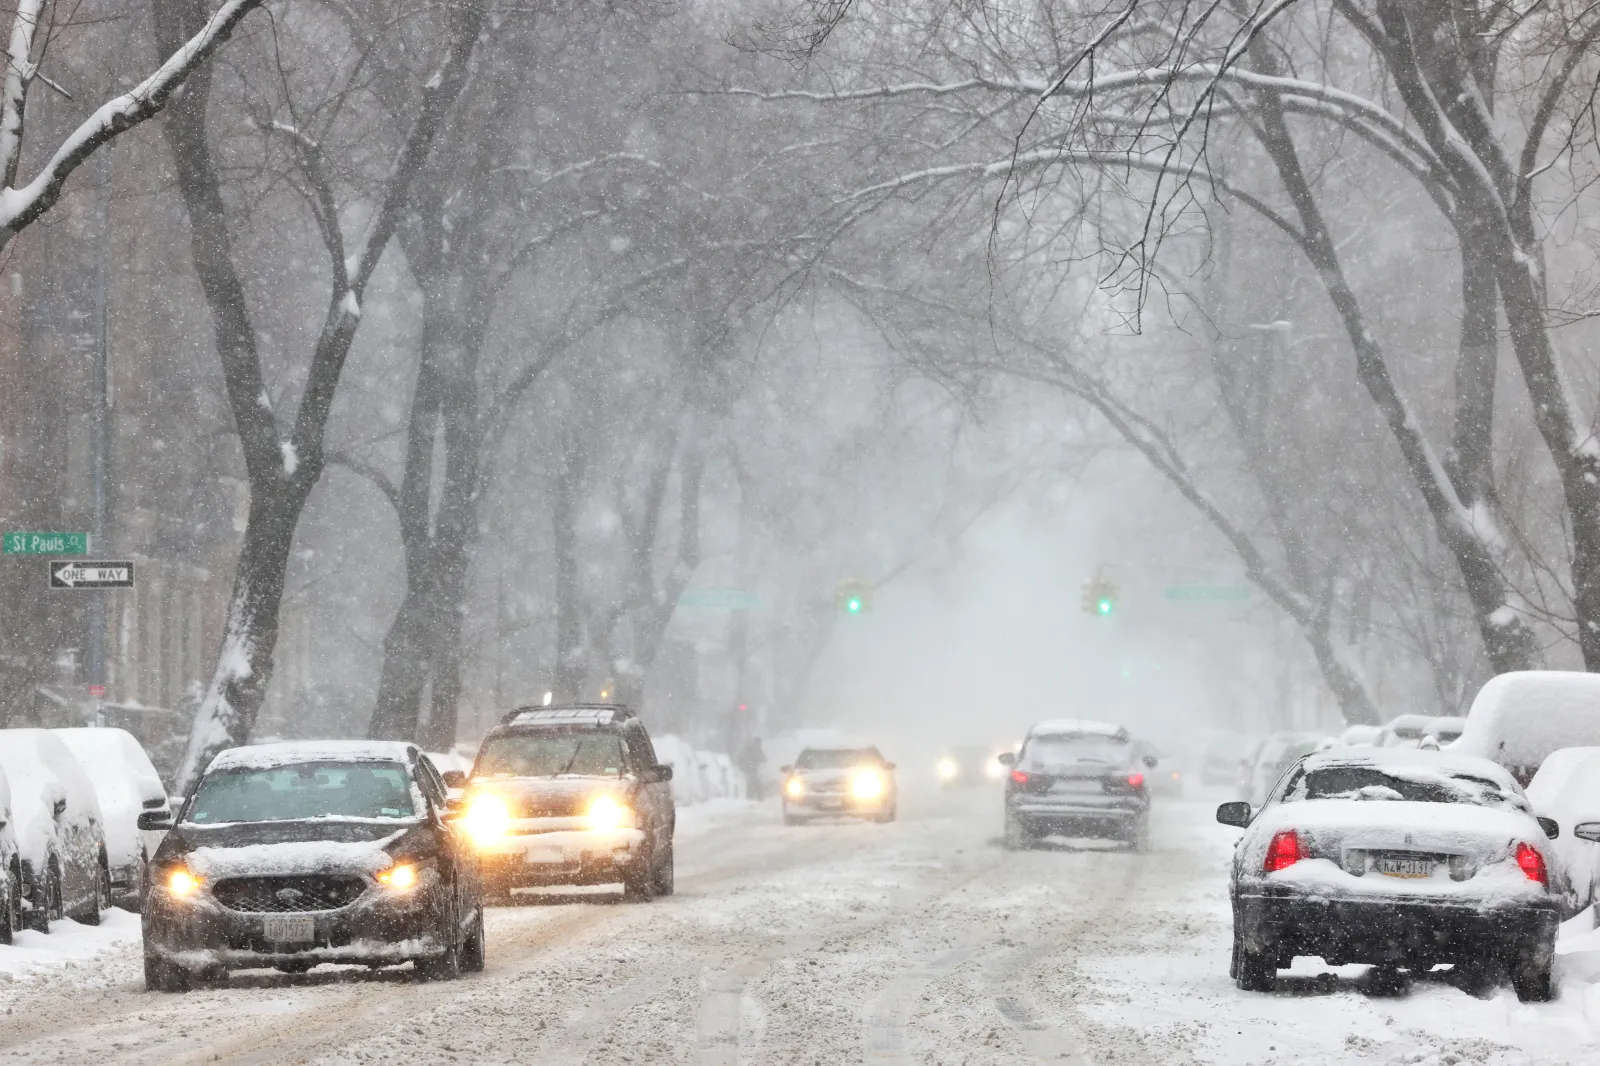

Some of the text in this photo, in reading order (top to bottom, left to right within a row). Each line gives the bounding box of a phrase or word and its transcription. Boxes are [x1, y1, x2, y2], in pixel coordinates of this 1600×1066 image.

[13, 535, 26, 551] St
[31, 535, 65, 551] Pauls
[63, 569, 123, 580] ONE WAY
